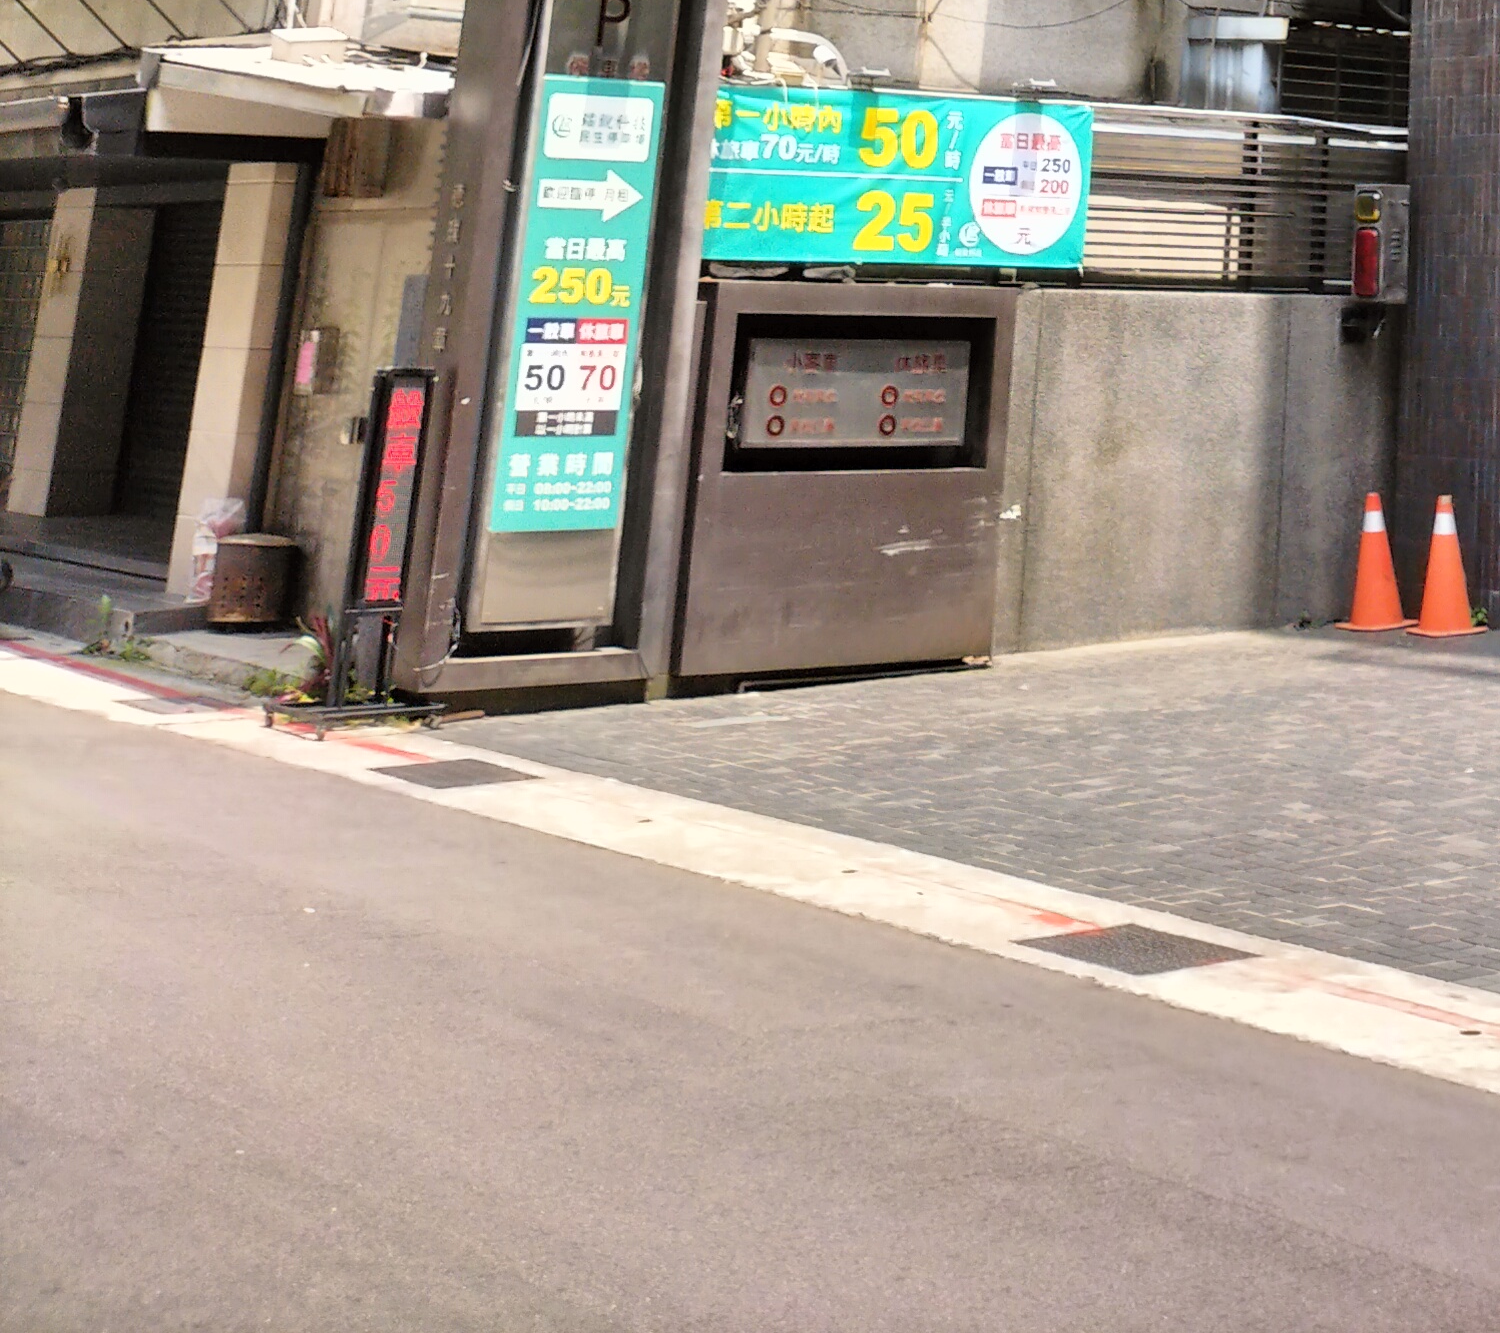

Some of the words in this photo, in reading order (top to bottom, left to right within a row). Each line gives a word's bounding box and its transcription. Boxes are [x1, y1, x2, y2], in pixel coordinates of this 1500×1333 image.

[714, 98, 842, 134] 第一小時內
[858, 107, 938, 169] 50
[1042, 158, 1071, 173] 250
[1040, 179, 1069, 194] 200
[704, 199, 835, 234] 第二小時起
[852, 190, 935, 253] 25
[544, 236, 627, 261] 當日最高
[1015, 227, 1031, 245] 元
[528, 265, 631, 307] 250元
[524, 364, 565, 391] 50
[579, 364, 616, 391] 70
